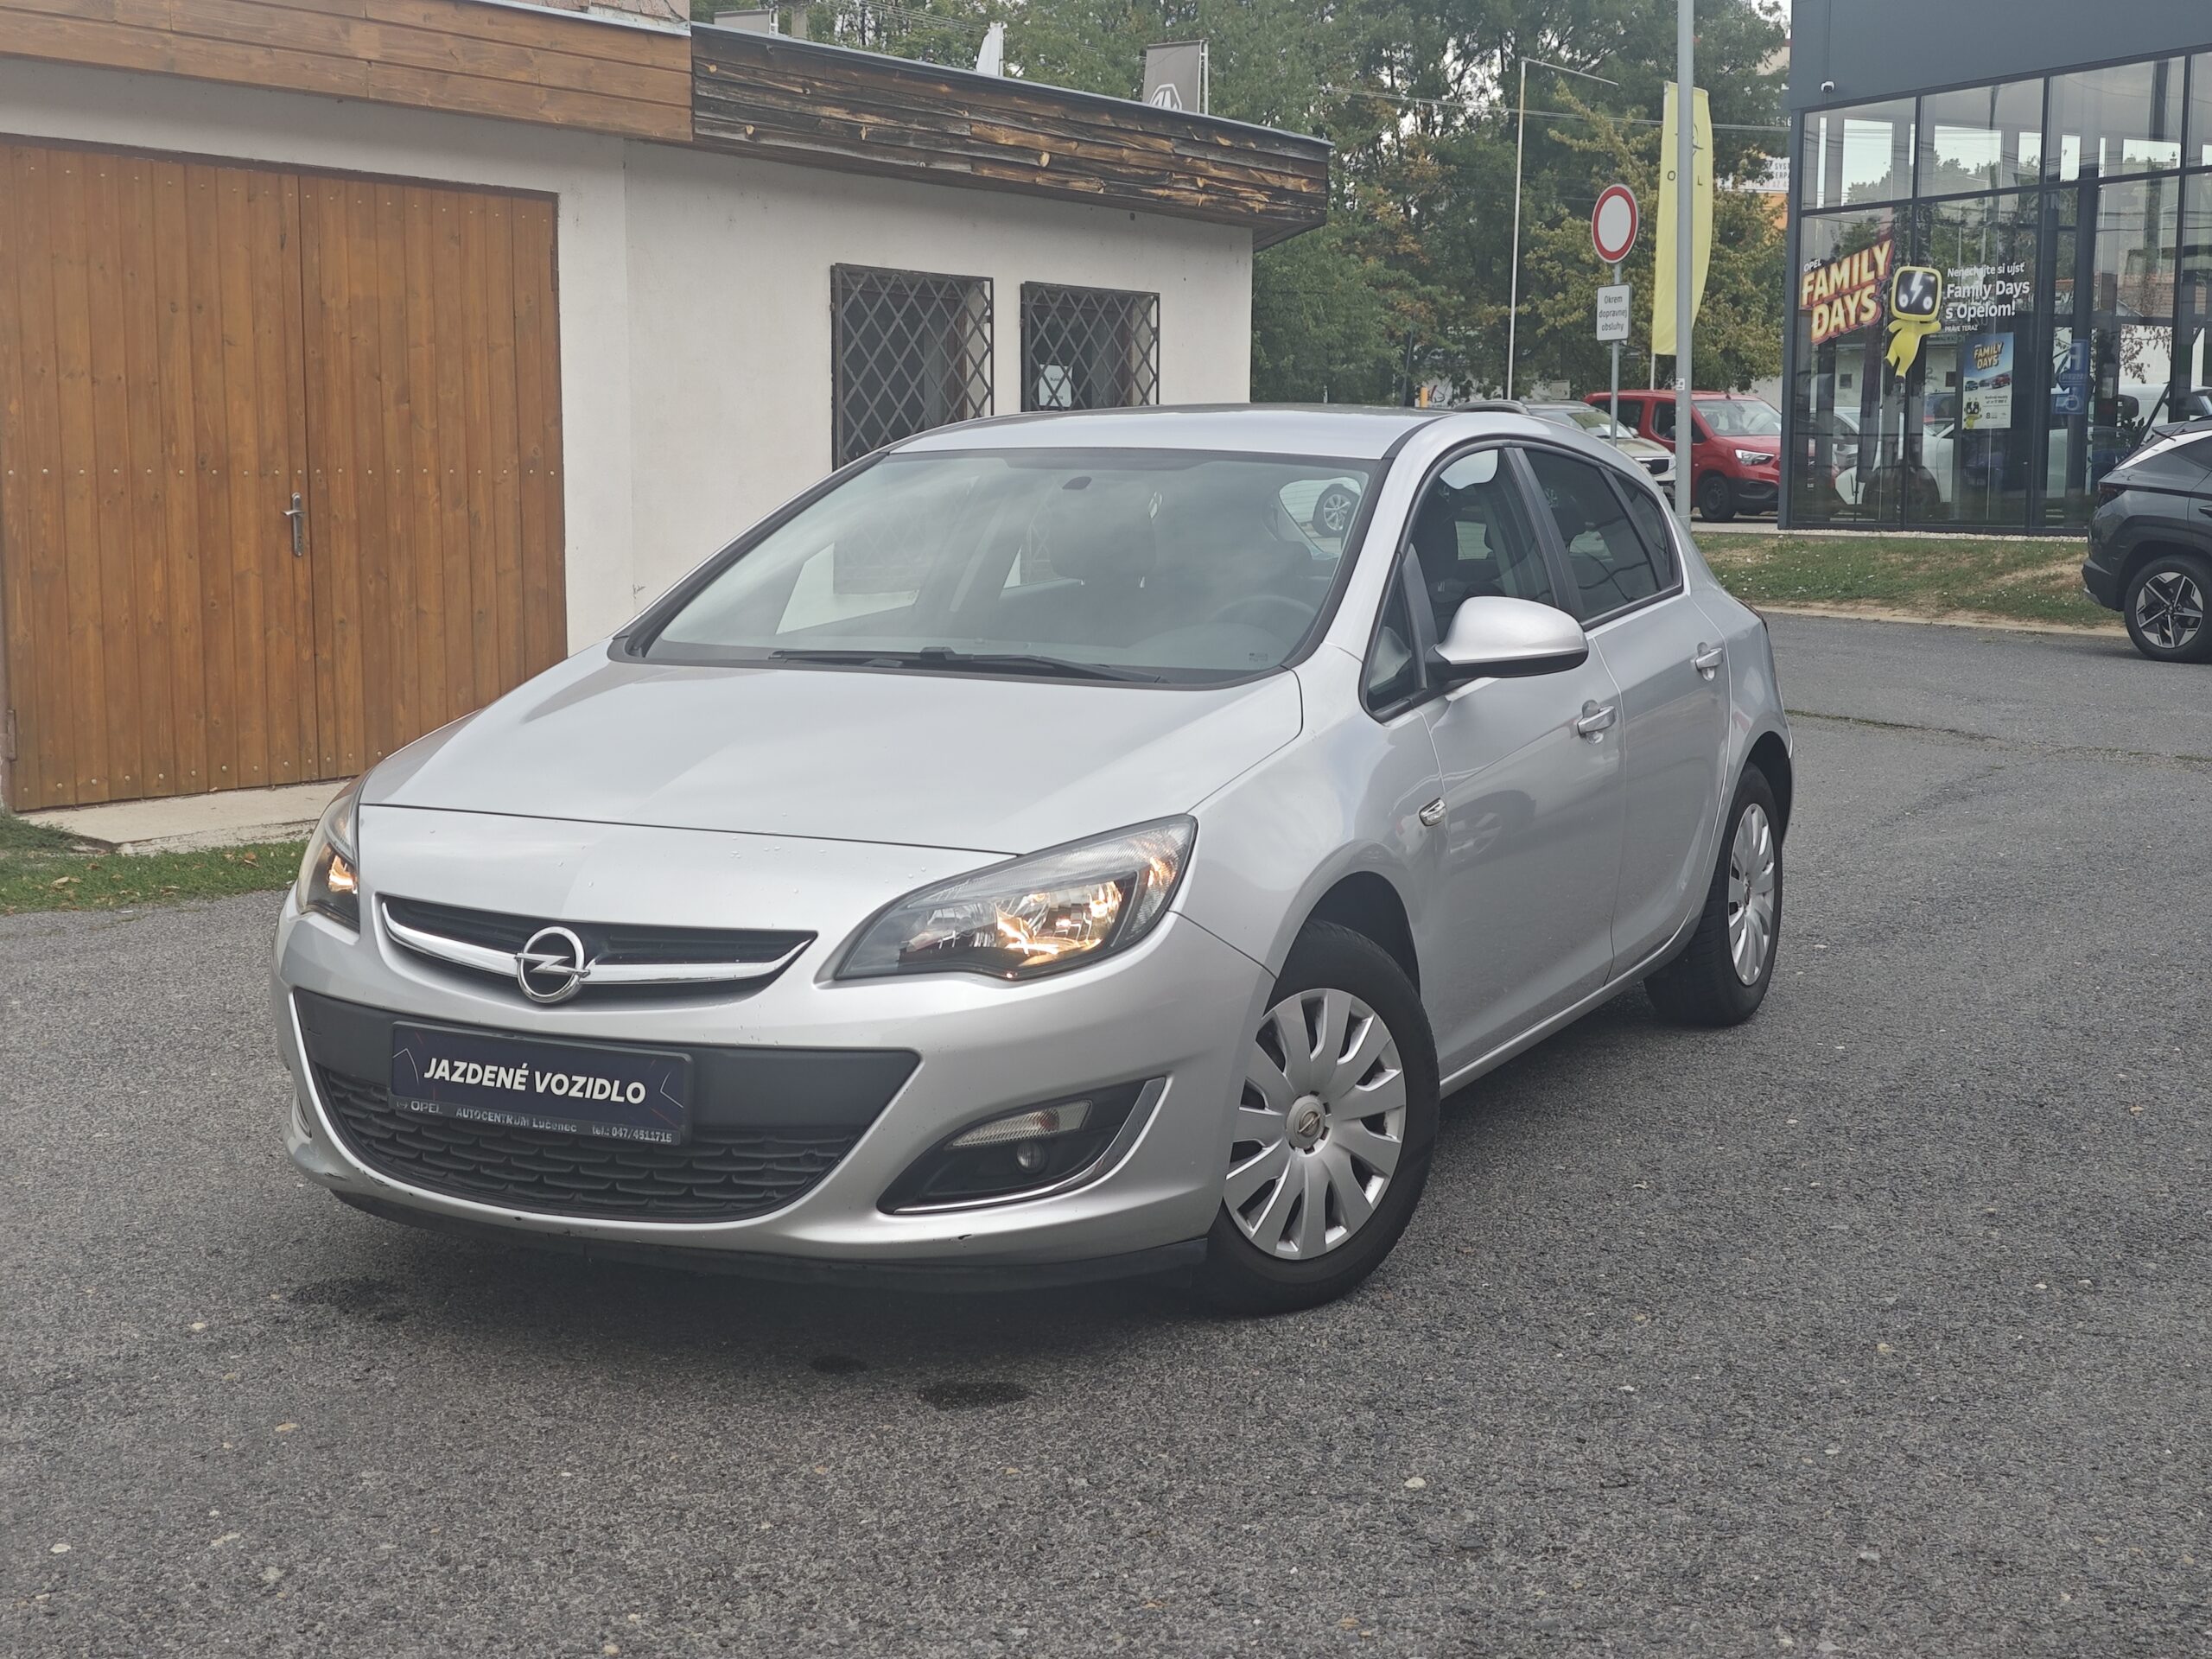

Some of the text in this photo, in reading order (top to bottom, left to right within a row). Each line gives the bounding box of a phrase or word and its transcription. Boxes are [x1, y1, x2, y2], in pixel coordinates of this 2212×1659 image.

[1801, 238, 1891, 308] FAMILY
[1803, 258, 1822, 272] OPEL
[1998, 263, 2005, 274] si
[1604, 296, 1623, 304] Okrem
[1947, 280, 2031, 301] Family Days
[1811, 283, 1878, 345] DAYS
[1945, 299, 2016, 322] s Opelom!
[1974, 342, 2004, 359] FAMILY
[1977, 354, 1999, 370] DAYS
[423, 1057, 646, 1105] JAZDENÉ VOZIDLO
[410, 1100, 443, 1116] OPEL
[455, 1107, 531, 1128] AUTOCENTRUM
